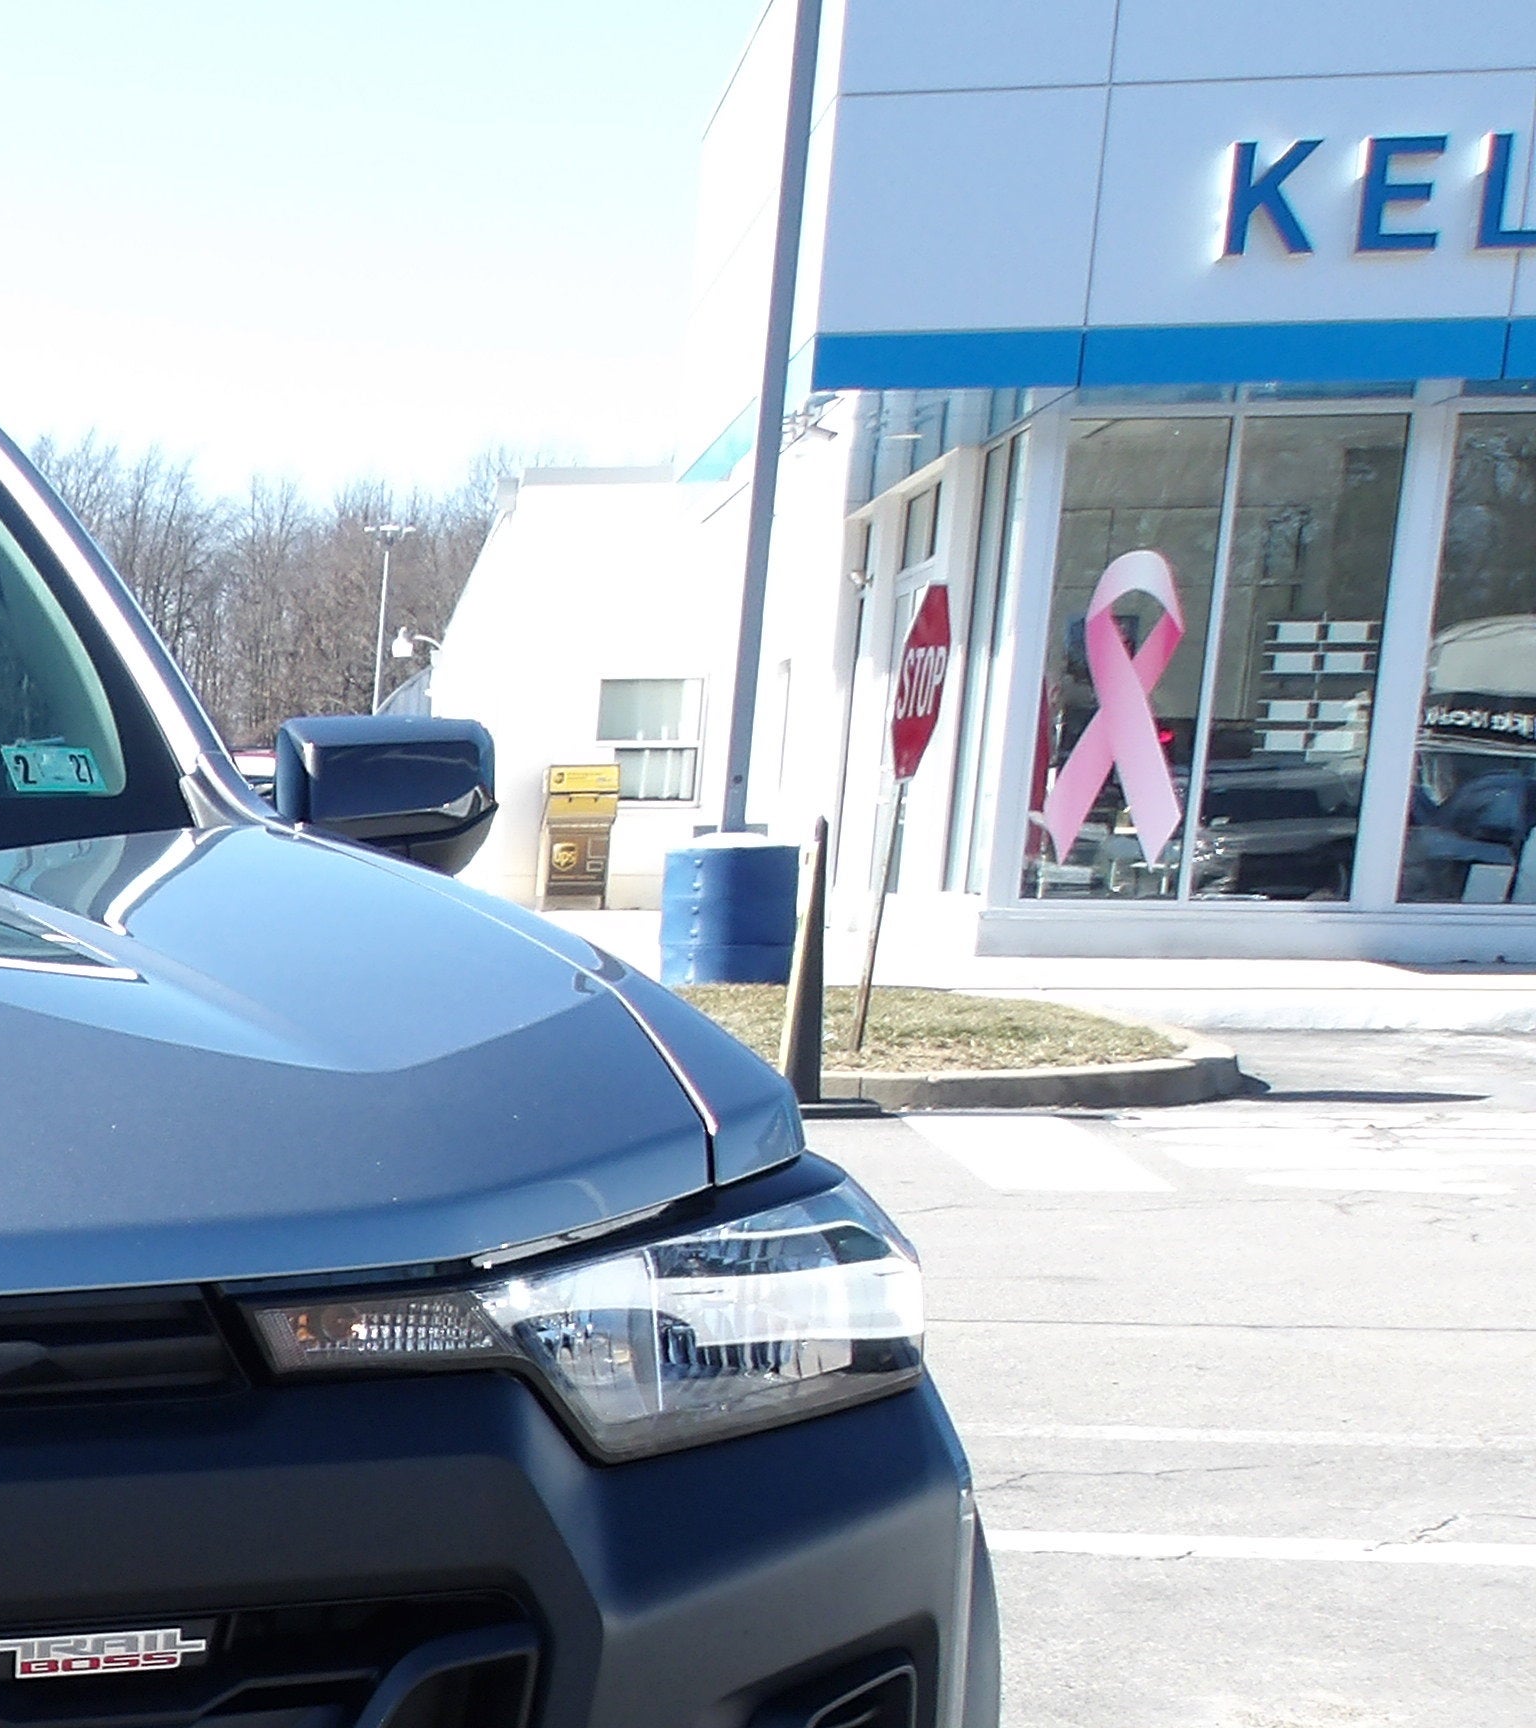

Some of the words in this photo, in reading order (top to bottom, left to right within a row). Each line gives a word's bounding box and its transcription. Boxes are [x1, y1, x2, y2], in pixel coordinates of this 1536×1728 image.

[895, 645, 948, 720] STOP
[69, 755, 94, 784] 27
[20, 1651, 178, 1675] BOSS
